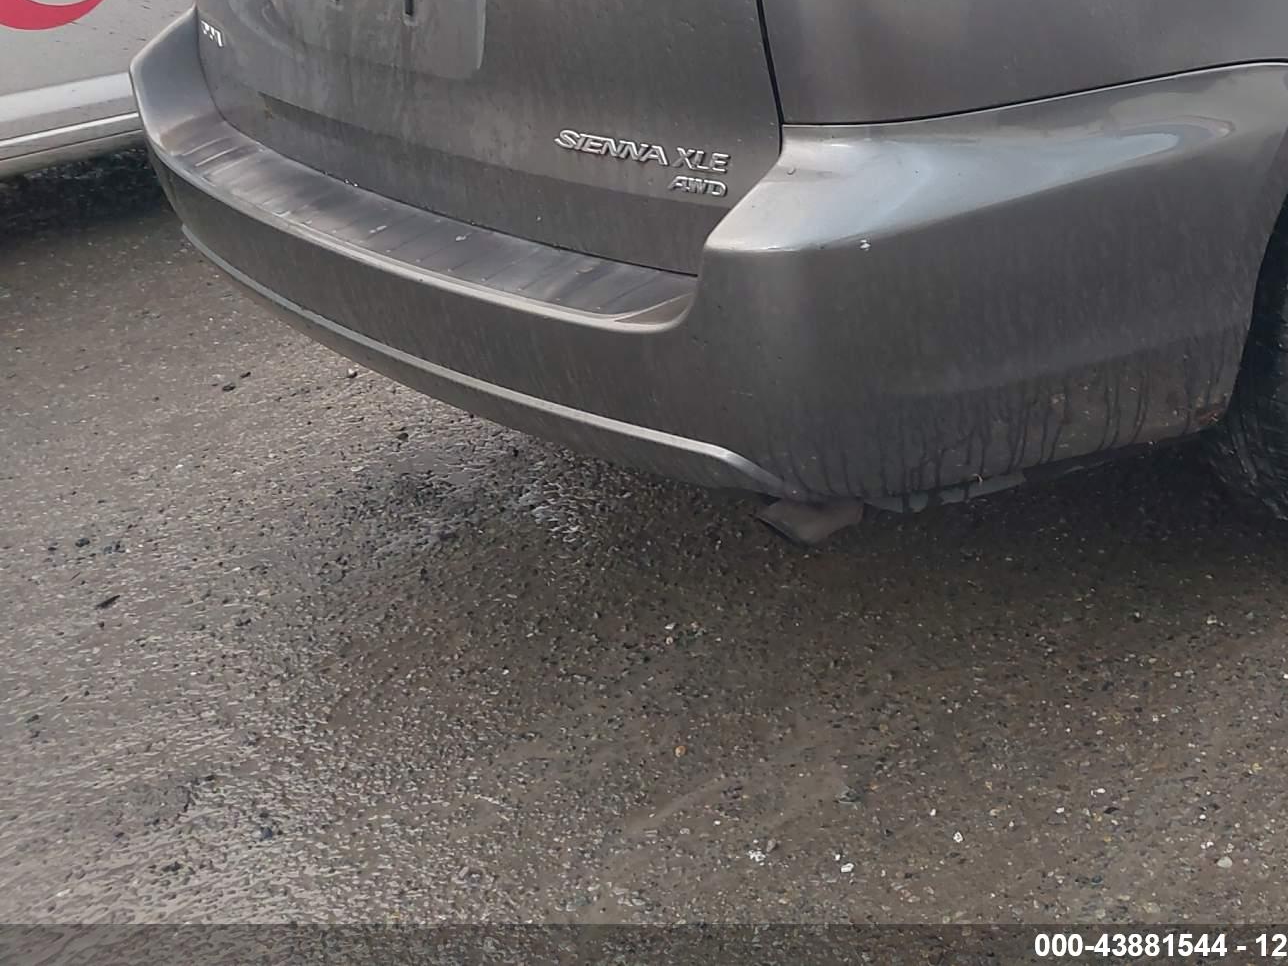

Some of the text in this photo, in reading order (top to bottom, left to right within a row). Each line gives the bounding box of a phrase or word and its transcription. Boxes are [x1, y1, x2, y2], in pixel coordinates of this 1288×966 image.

[554, 129, 731, 173] SIENNA XLE
[668, 175, 728, 197] AWD
